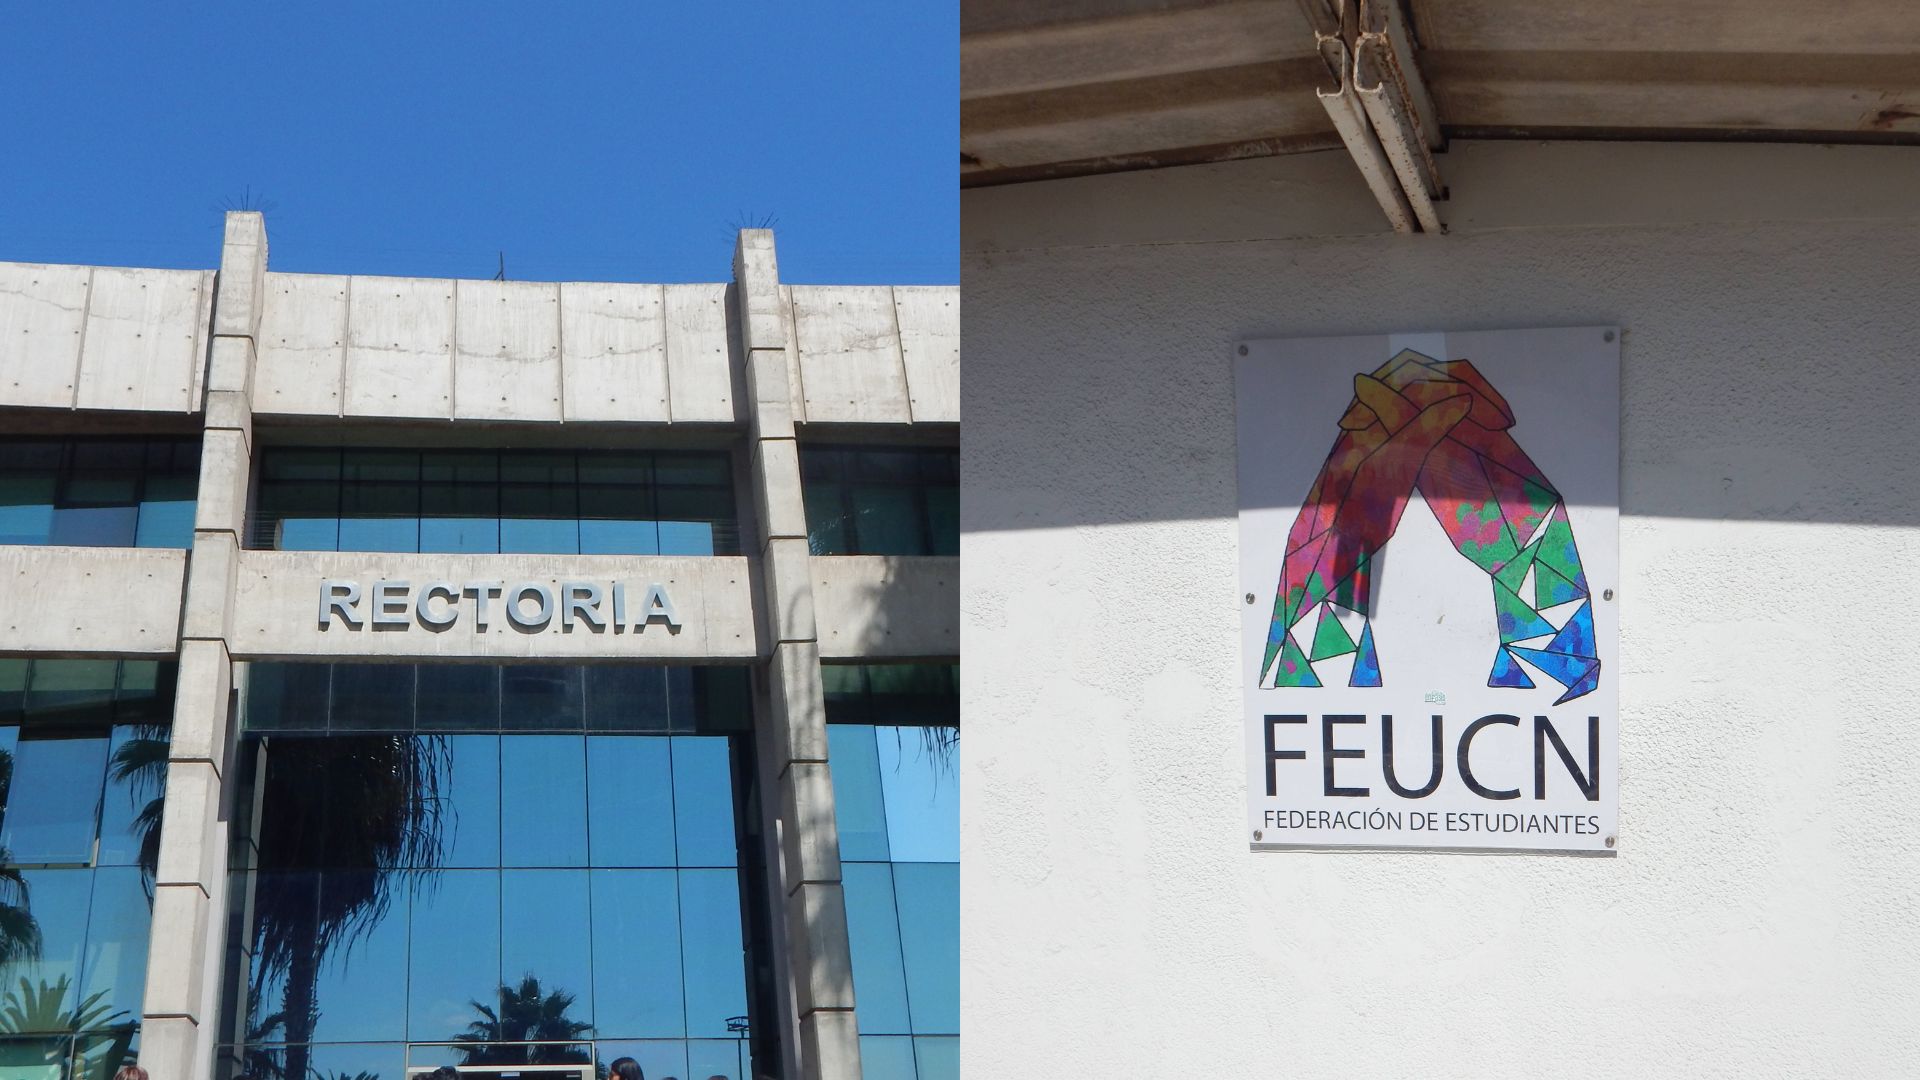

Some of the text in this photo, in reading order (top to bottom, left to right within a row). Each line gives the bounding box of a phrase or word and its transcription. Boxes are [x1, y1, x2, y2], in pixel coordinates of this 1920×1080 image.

[319, 581, 682, 635] RECTORIA
[1264, 714, 1600, 801] FEUCN
[1264, 808, 1600, 835] FEDERACIÓN DE ESTUDIANTES
